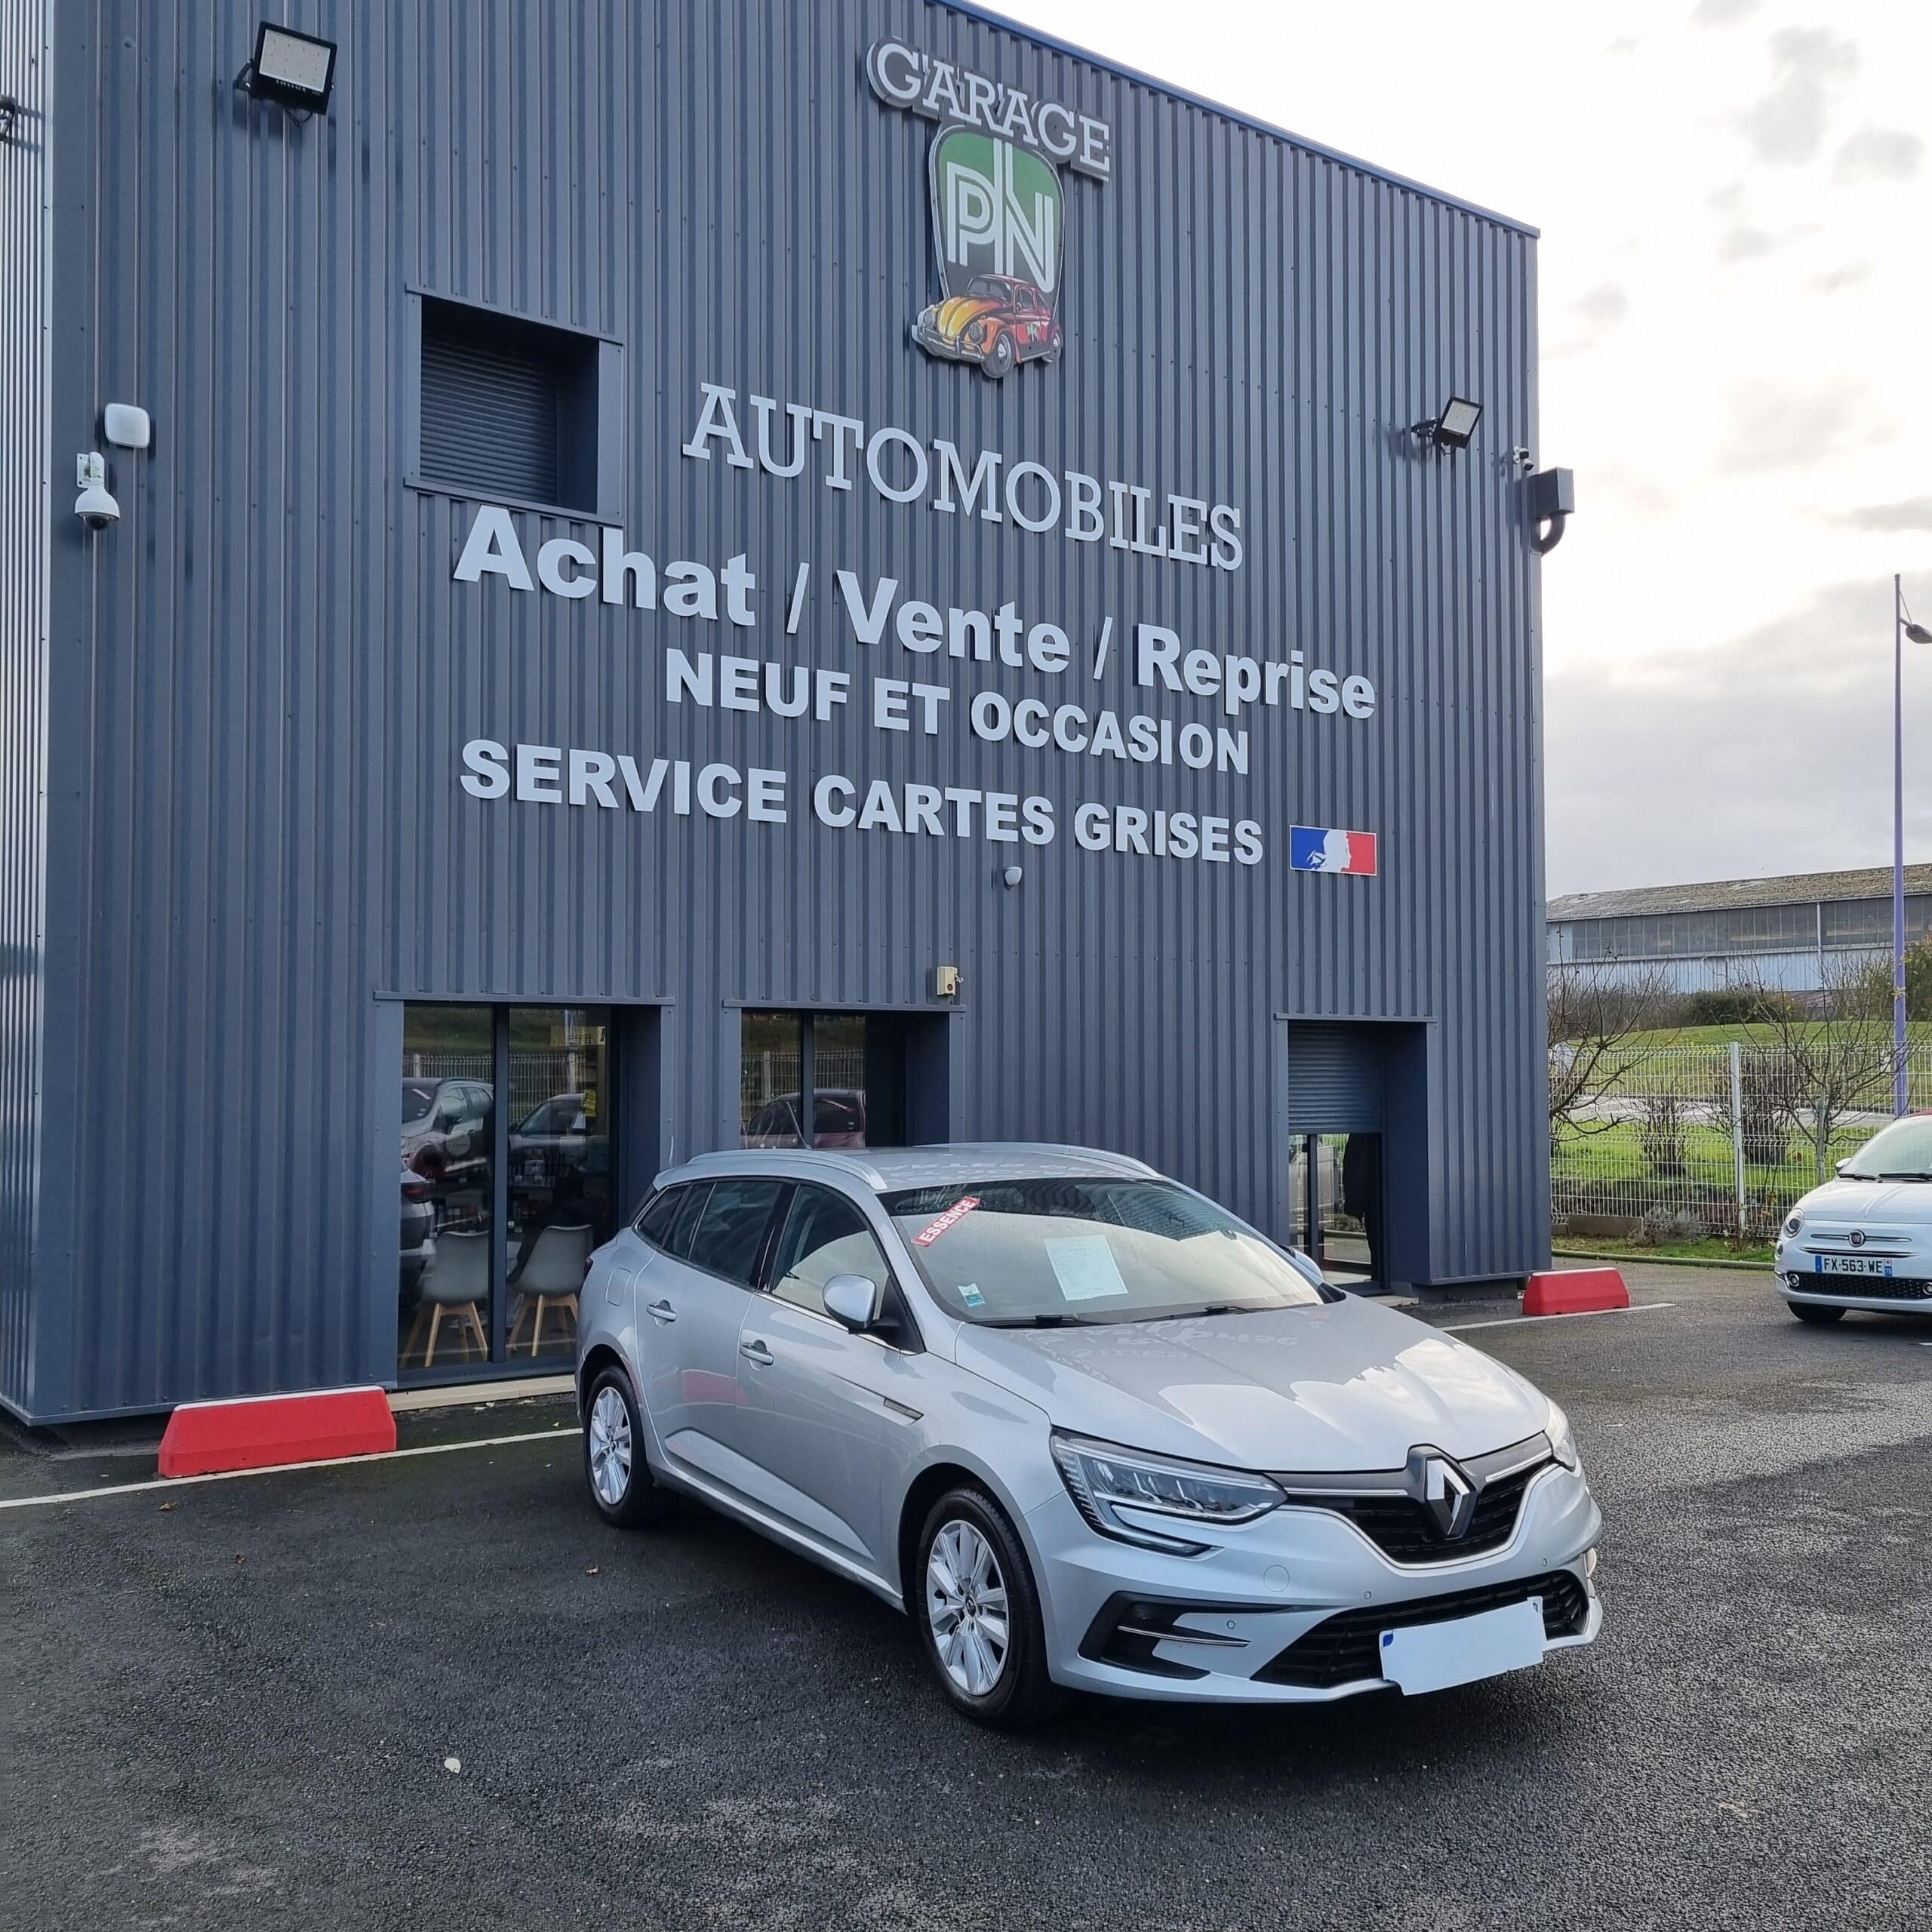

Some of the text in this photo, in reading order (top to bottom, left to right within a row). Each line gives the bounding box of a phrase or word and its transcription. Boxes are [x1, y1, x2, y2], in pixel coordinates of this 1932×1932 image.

[875, 42, 1111, 173] GARAGE
[683, 383, 1242, 571] AUTOMOBILES
[454, 505, 1375, 719] Achat / Vente / Reprise
[666, 648, 1248, 774] NEUF ET OCCASION
[460, 739, 1263, 864] SERVICE CARTES GRISES
[918, 1200, 976, 1242] ESSENCE
